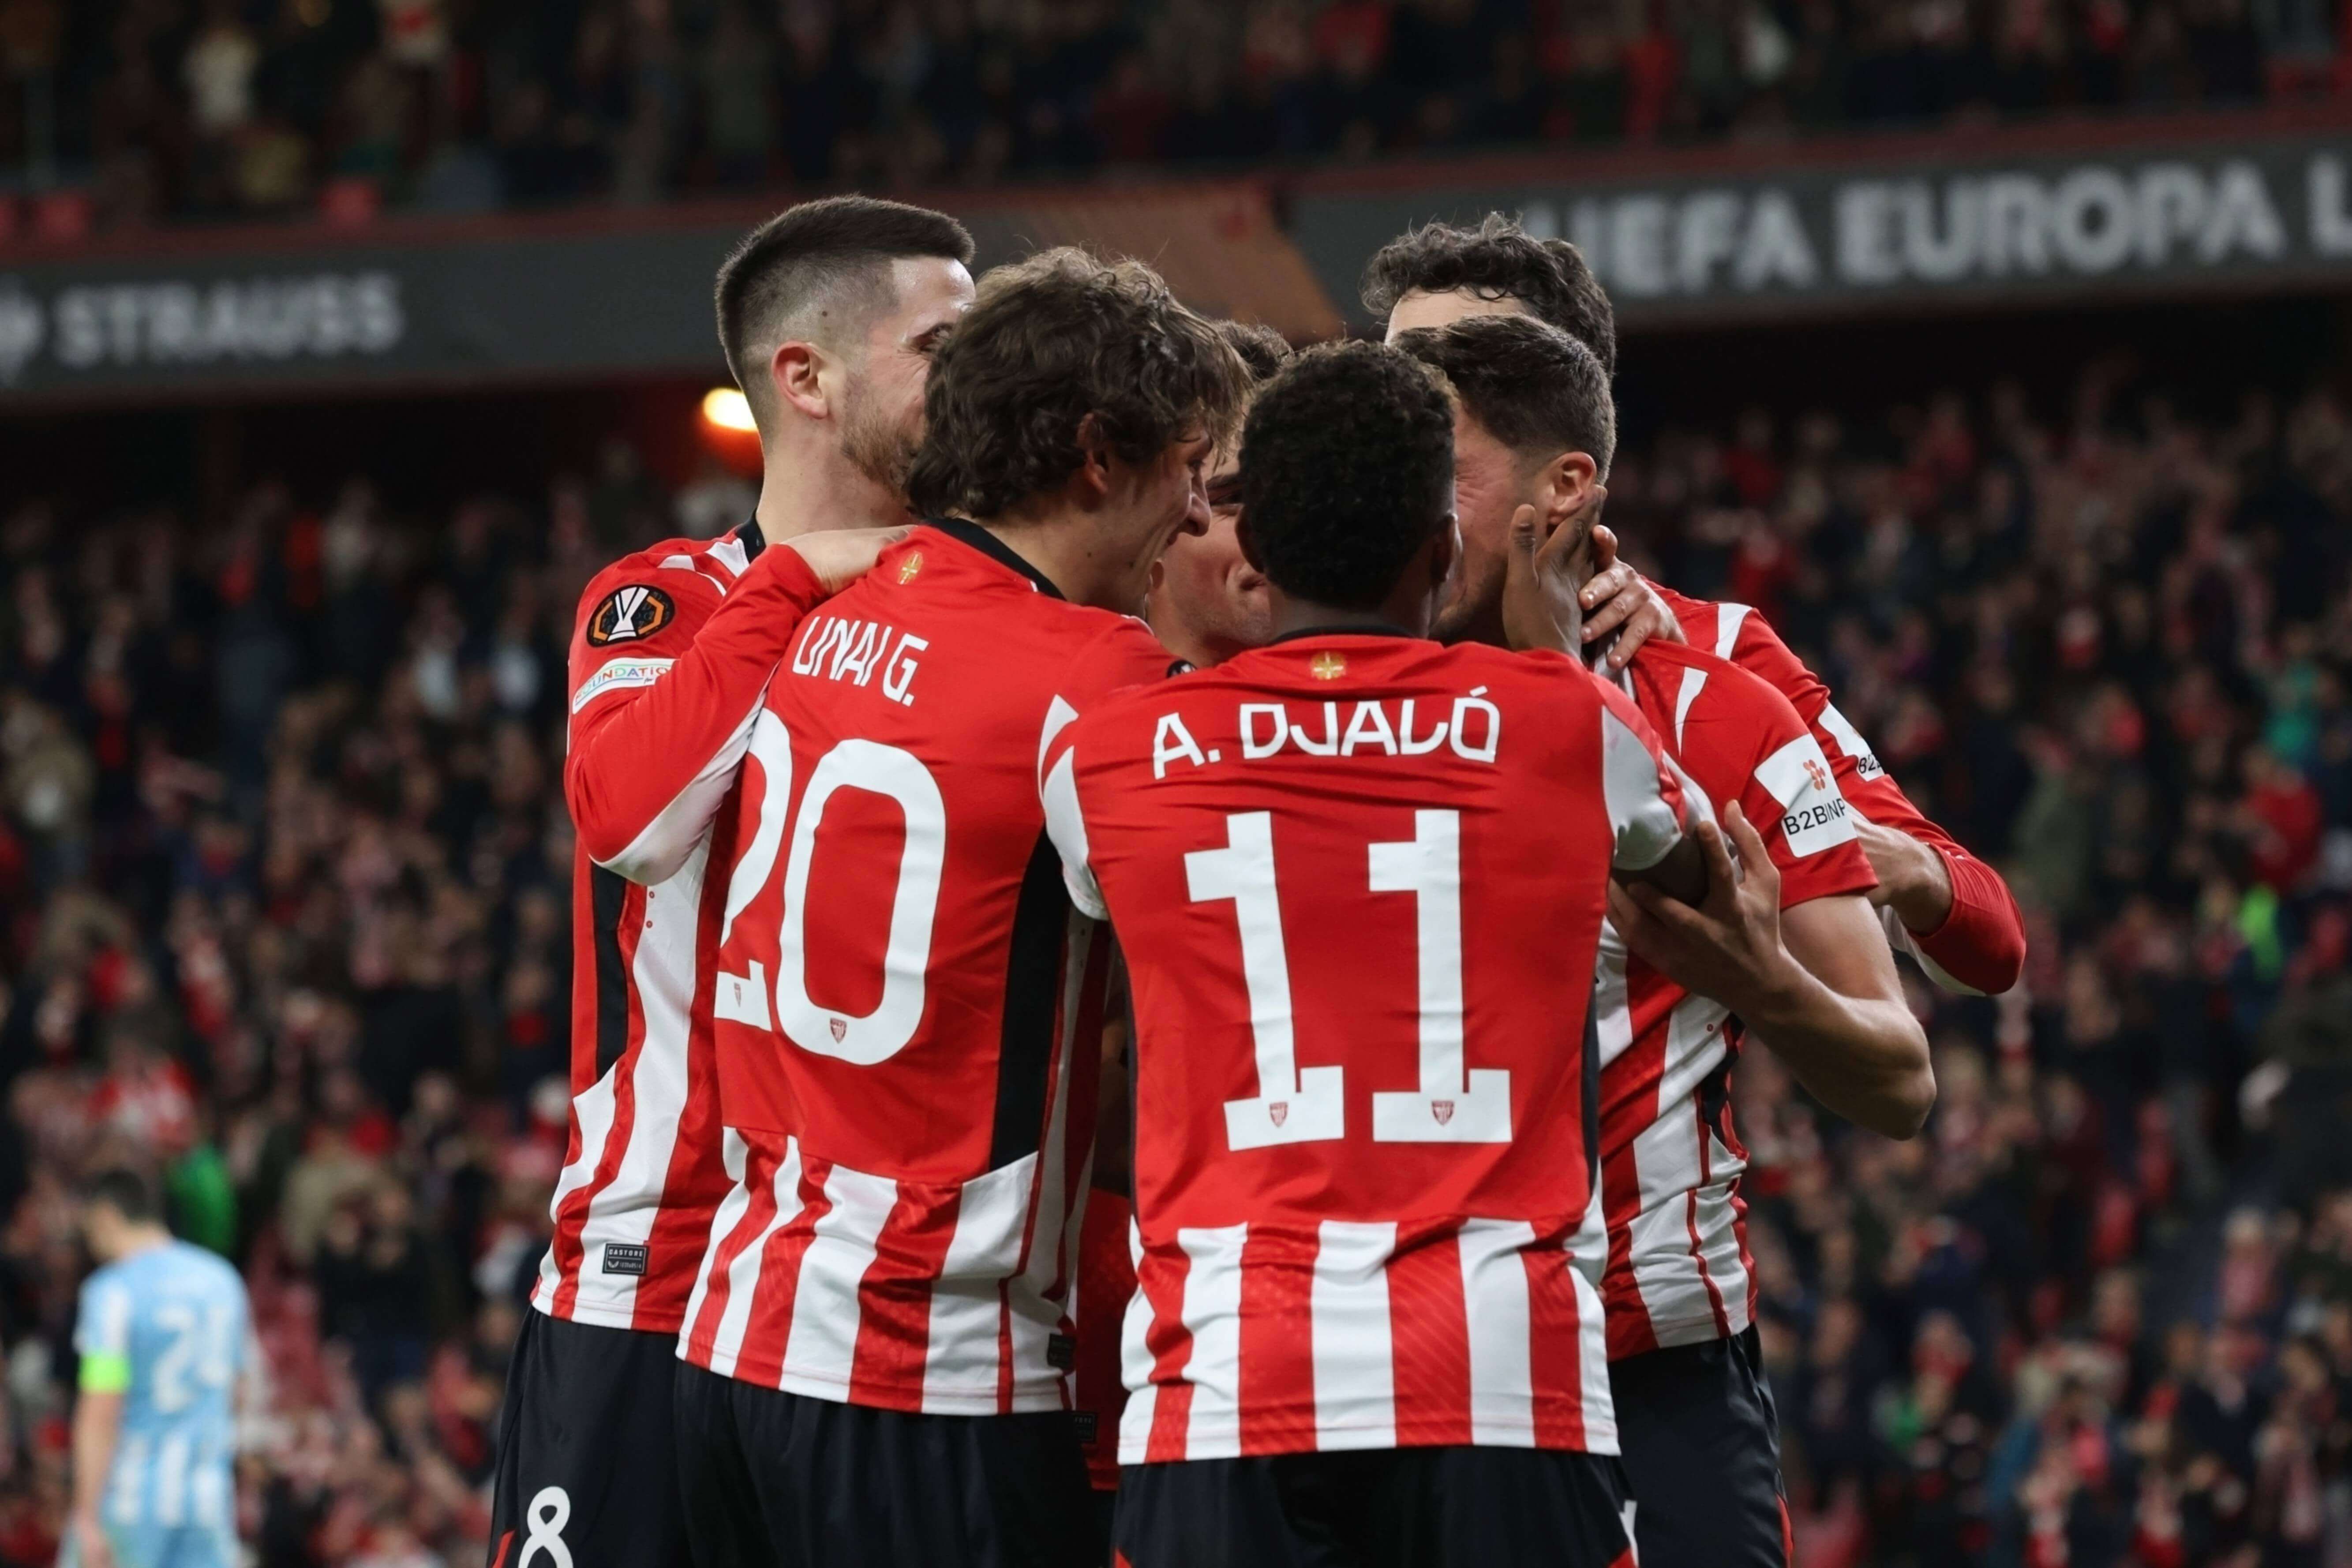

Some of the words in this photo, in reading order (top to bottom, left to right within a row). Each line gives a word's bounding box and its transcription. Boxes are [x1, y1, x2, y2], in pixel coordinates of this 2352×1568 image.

[1834, 158, 2289, 283] EUROPA
[55, 271, 404, 368] STRAUSS
[793, 616, 892, 687] UNAI
[883, 633, 929, 706] G.
[1153, 712, 1221, 779] A.
[1239, 685, 1500, 763] DJALÓ
[714, 707, 946, 1065] 20
[1184, 809, 1513, 1151] 11
[609, 1249, 643, 1257] CASTORE
[518, 1486, 573, 1568] 8
